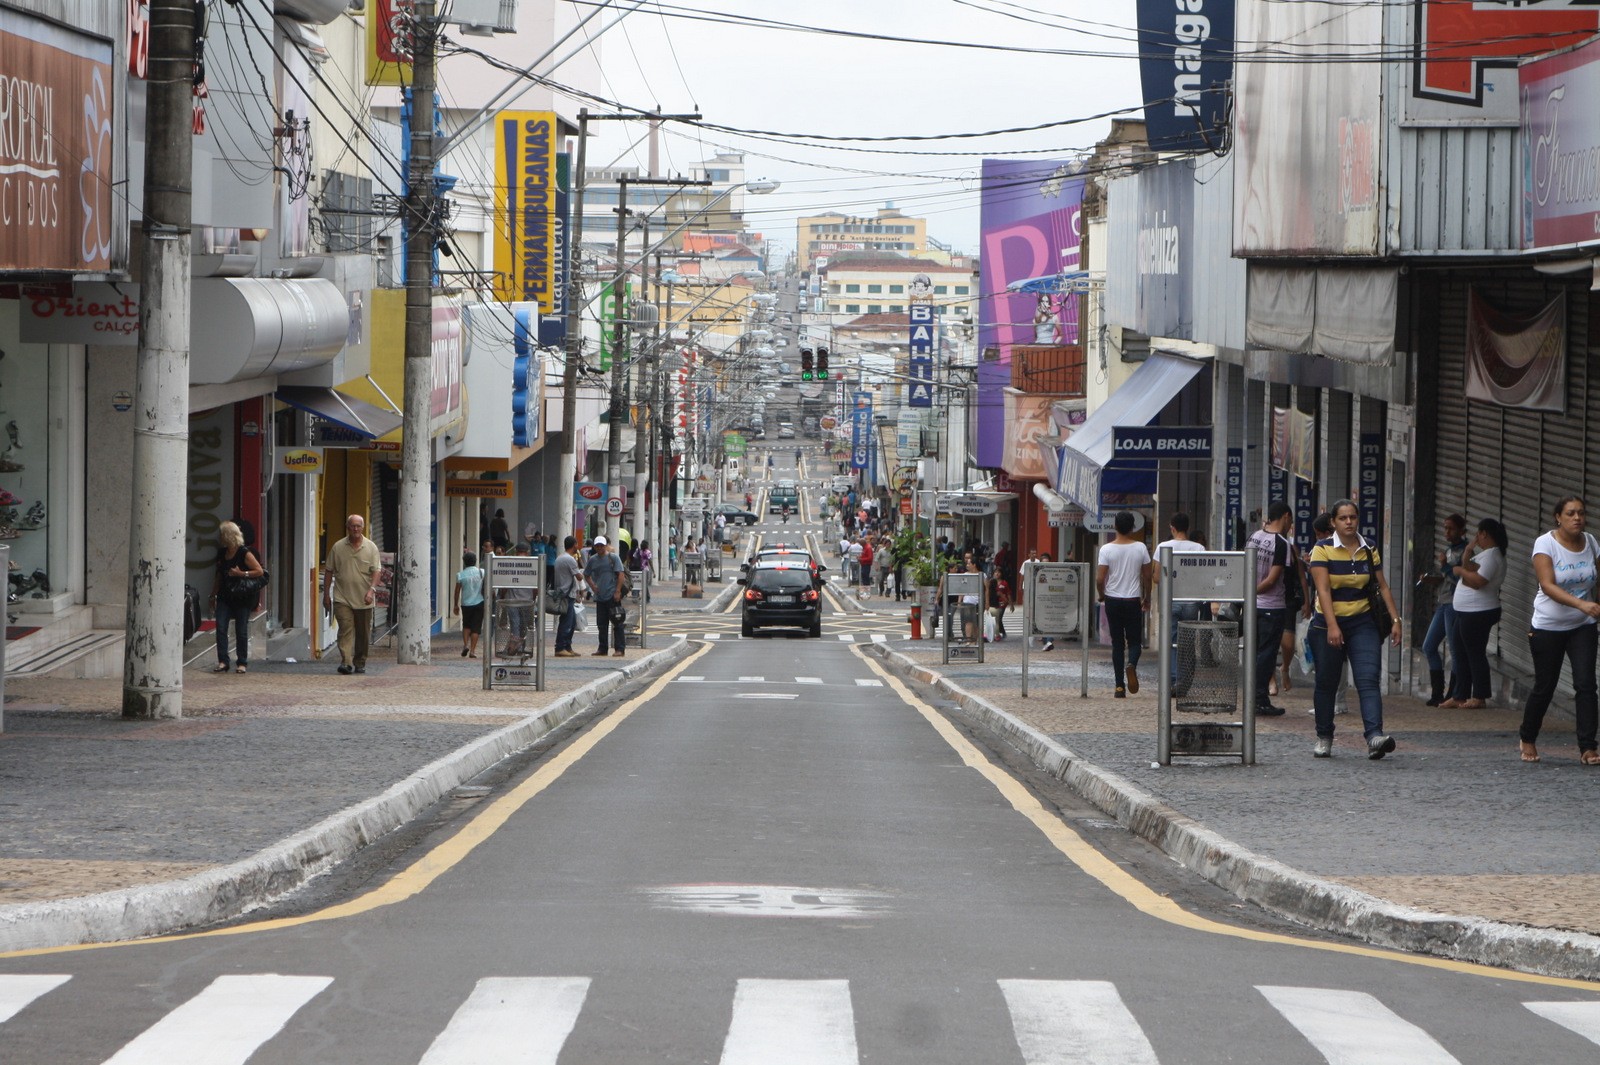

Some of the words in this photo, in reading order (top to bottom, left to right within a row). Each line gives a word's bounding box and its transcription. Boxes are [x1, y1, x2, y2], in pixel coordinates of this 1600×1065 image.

[523, 119, 550, 307] PERNAMBUCANAS
[911, 306, 931, 399] BAHIA
[1115, 439, 1152, 450] LOJA
[1156, 439, 1210, 450] BRASIL
[285, 454, 317, 464] Usaflex
[447, 487, 507, 496] PERNAMBUCANAS
